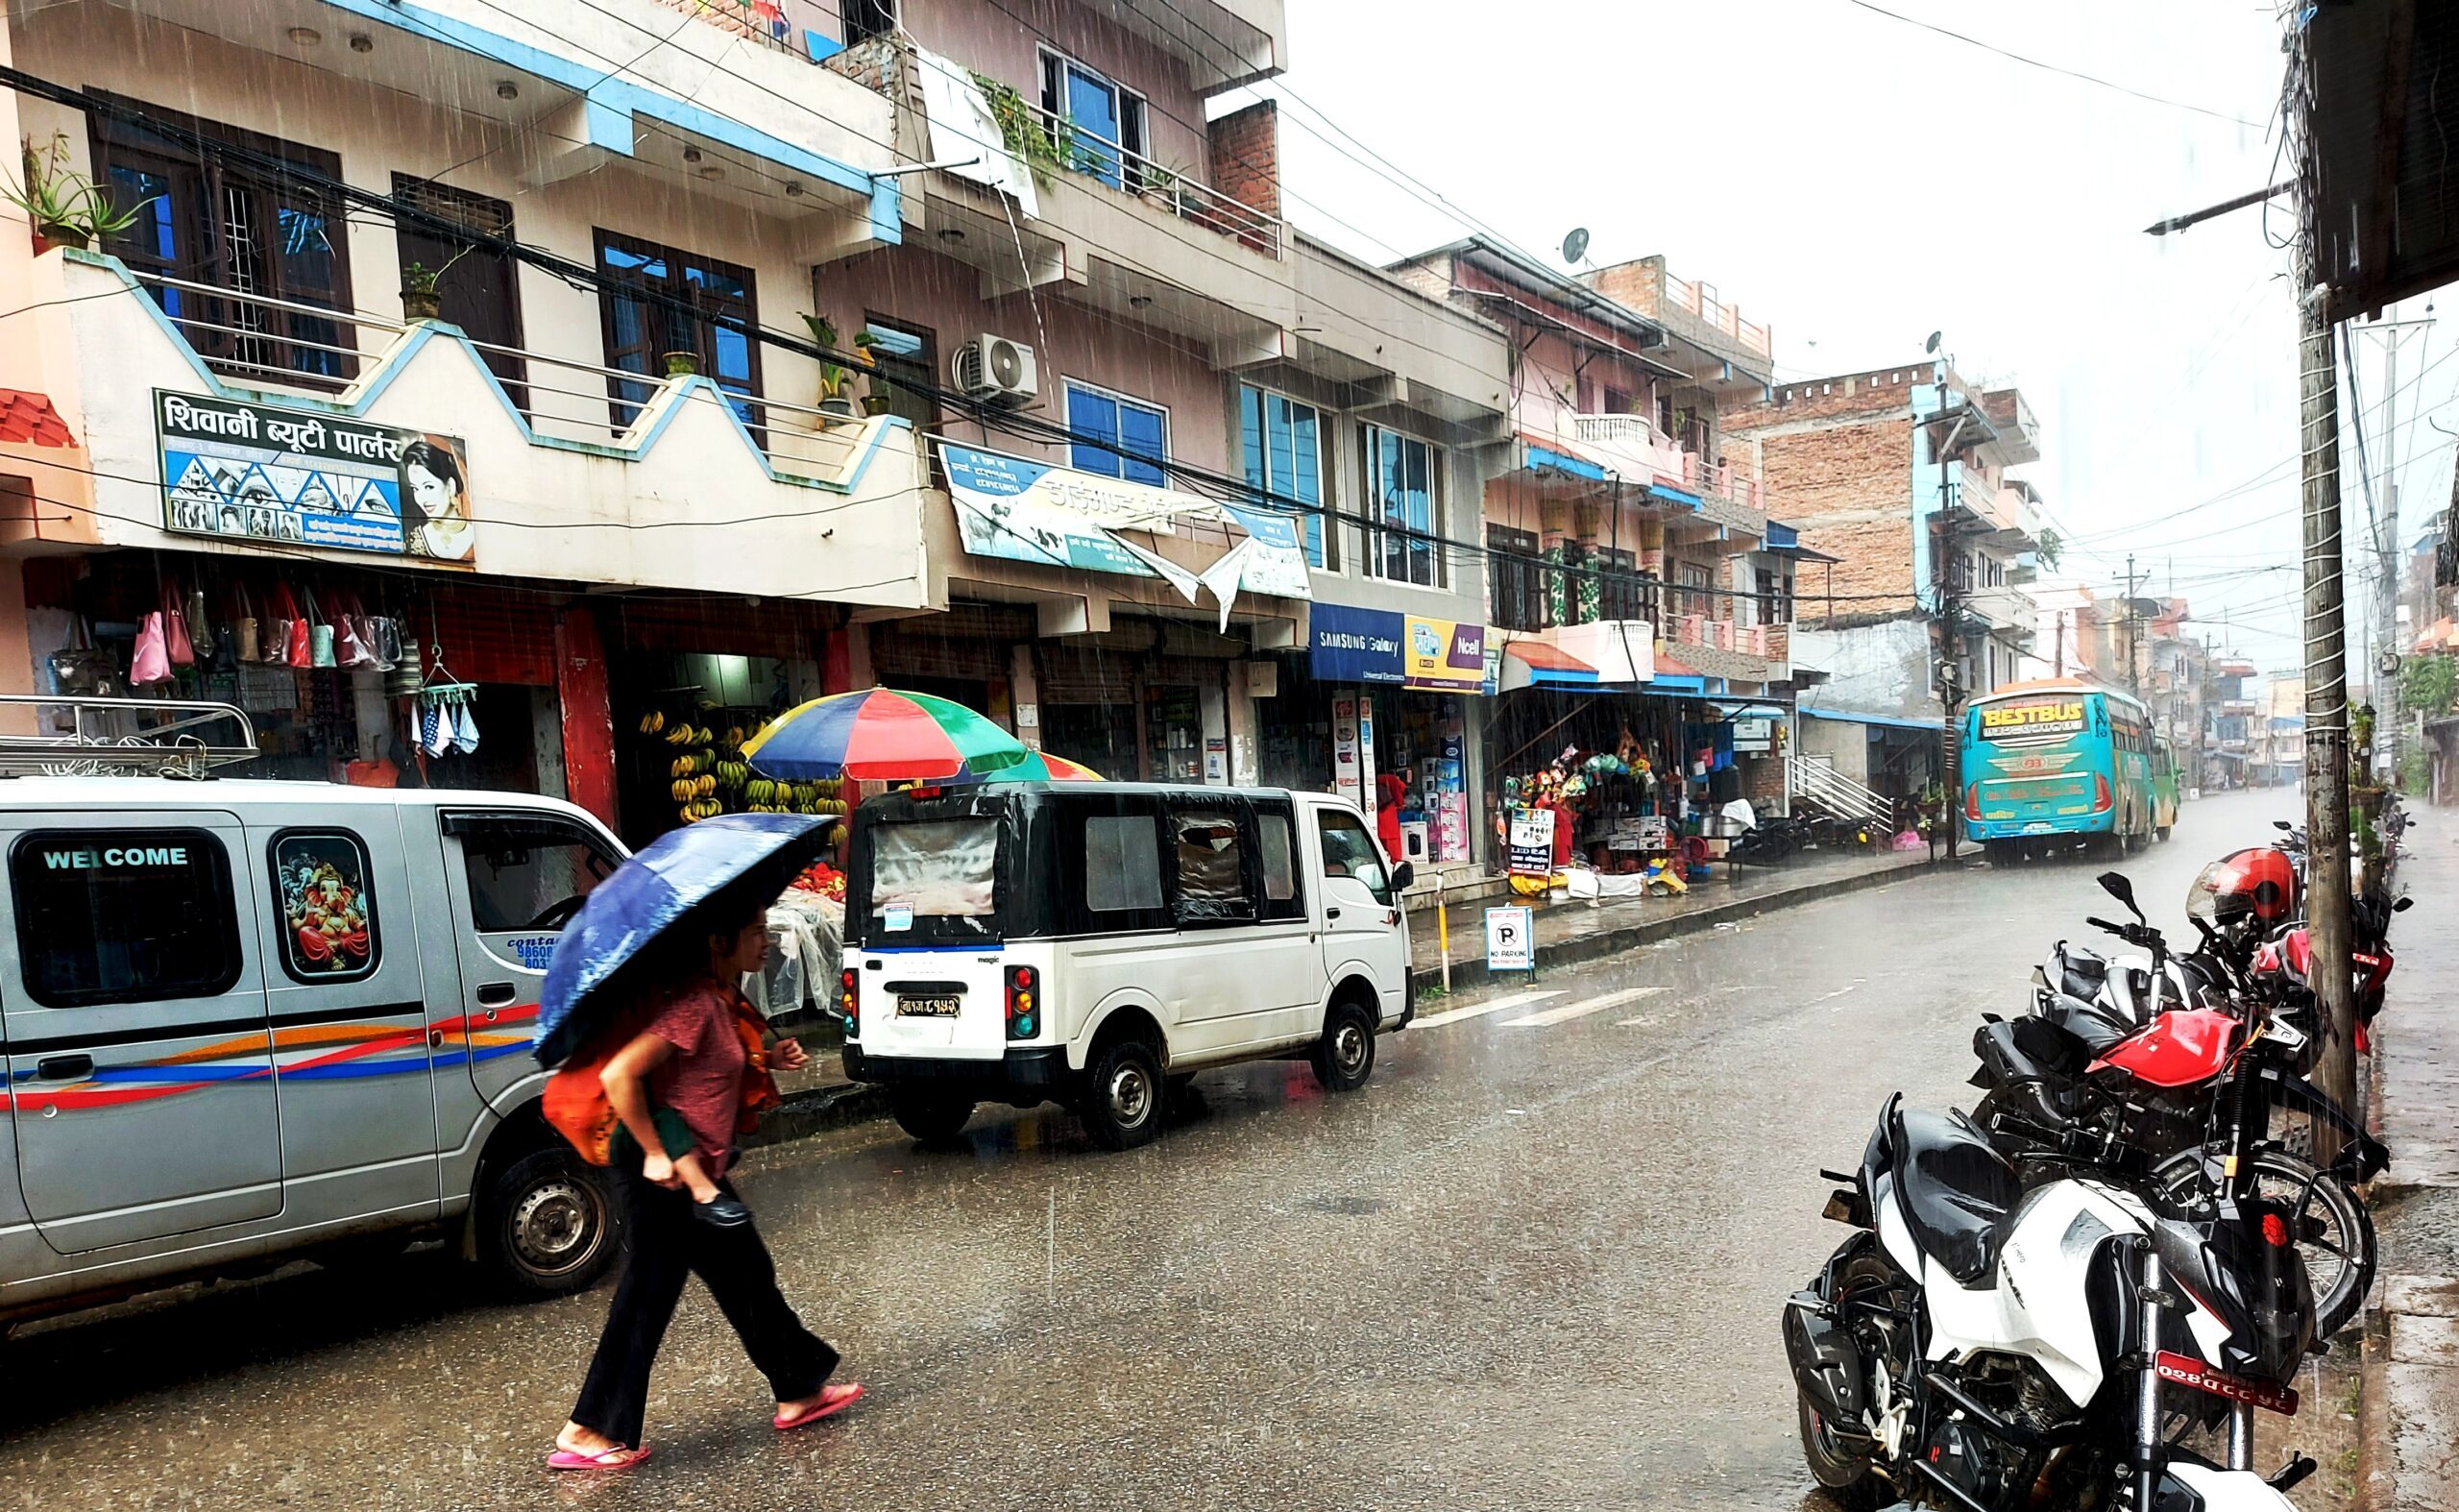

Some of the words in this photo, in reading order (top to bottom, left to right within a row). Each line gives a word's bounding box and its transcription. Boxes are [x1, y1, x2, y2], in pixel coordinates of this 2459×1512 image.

[164, 396, 258, 440] शिवानी
[266, 419, 327, 453] ब्यूटी
[333, 430, 402, 462] पार्लर
[1320, 631, 1366, 649] SAMSUNG
[1369, 636, 1399, 658] Galaxy
[1457, 636, 1480, 656] Ncell
[1983, 703, 2082, 726] BESTBUS
[43, 847, 188, 869] WELCOME
[507, 936, 560, 947] conta
[524, 959, 549, 969] 803
[978, 956, 1000, 965] magic
